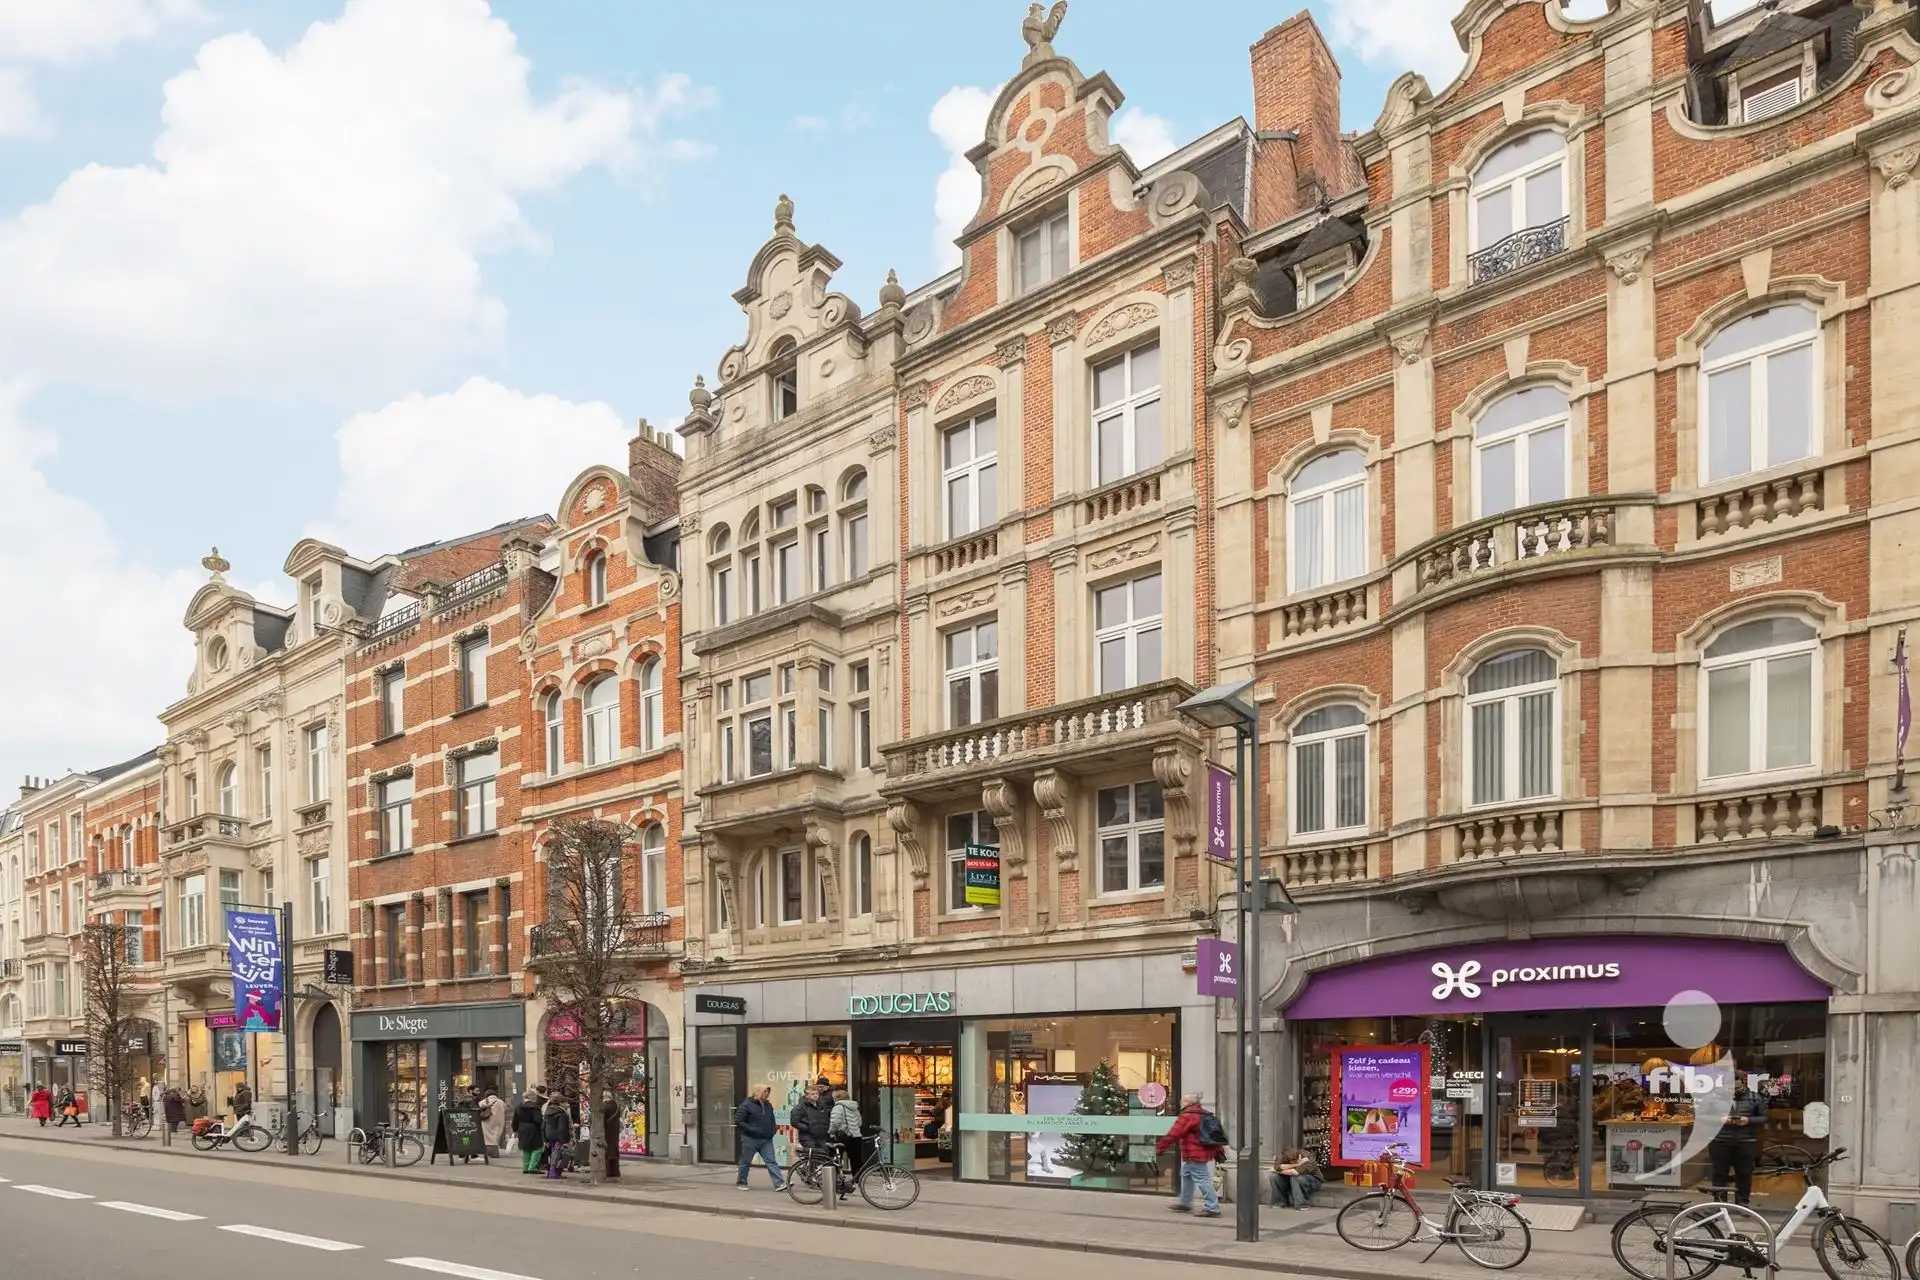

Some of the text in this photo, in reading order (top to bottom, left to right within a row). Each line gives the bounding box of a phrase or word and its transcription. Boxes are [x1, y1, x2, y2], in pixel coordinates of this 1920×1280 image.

[967, 847, 1000, 858] TE KOO
[245, 951, 281, 968] ter
[328, 972, 336, 982] De
[1492, 962, 1620, 987] proximus
[1213, 975, 1237, 985] proximus
[706, 1000, 740, 1010] DOUGLAS
[849, 991, 951, 1016] DOUGLAS
[379, 1015, 428, 1035] De Slegte
[61, 1043, 87, 1053] WE
[1367, 1057, 1376, 1066] je
[1348, 1064, 1380, 1072] kiezen.
[767, 1071, 794, 1081] GIVE
[1392, 1087, 1418, 1095] €299
